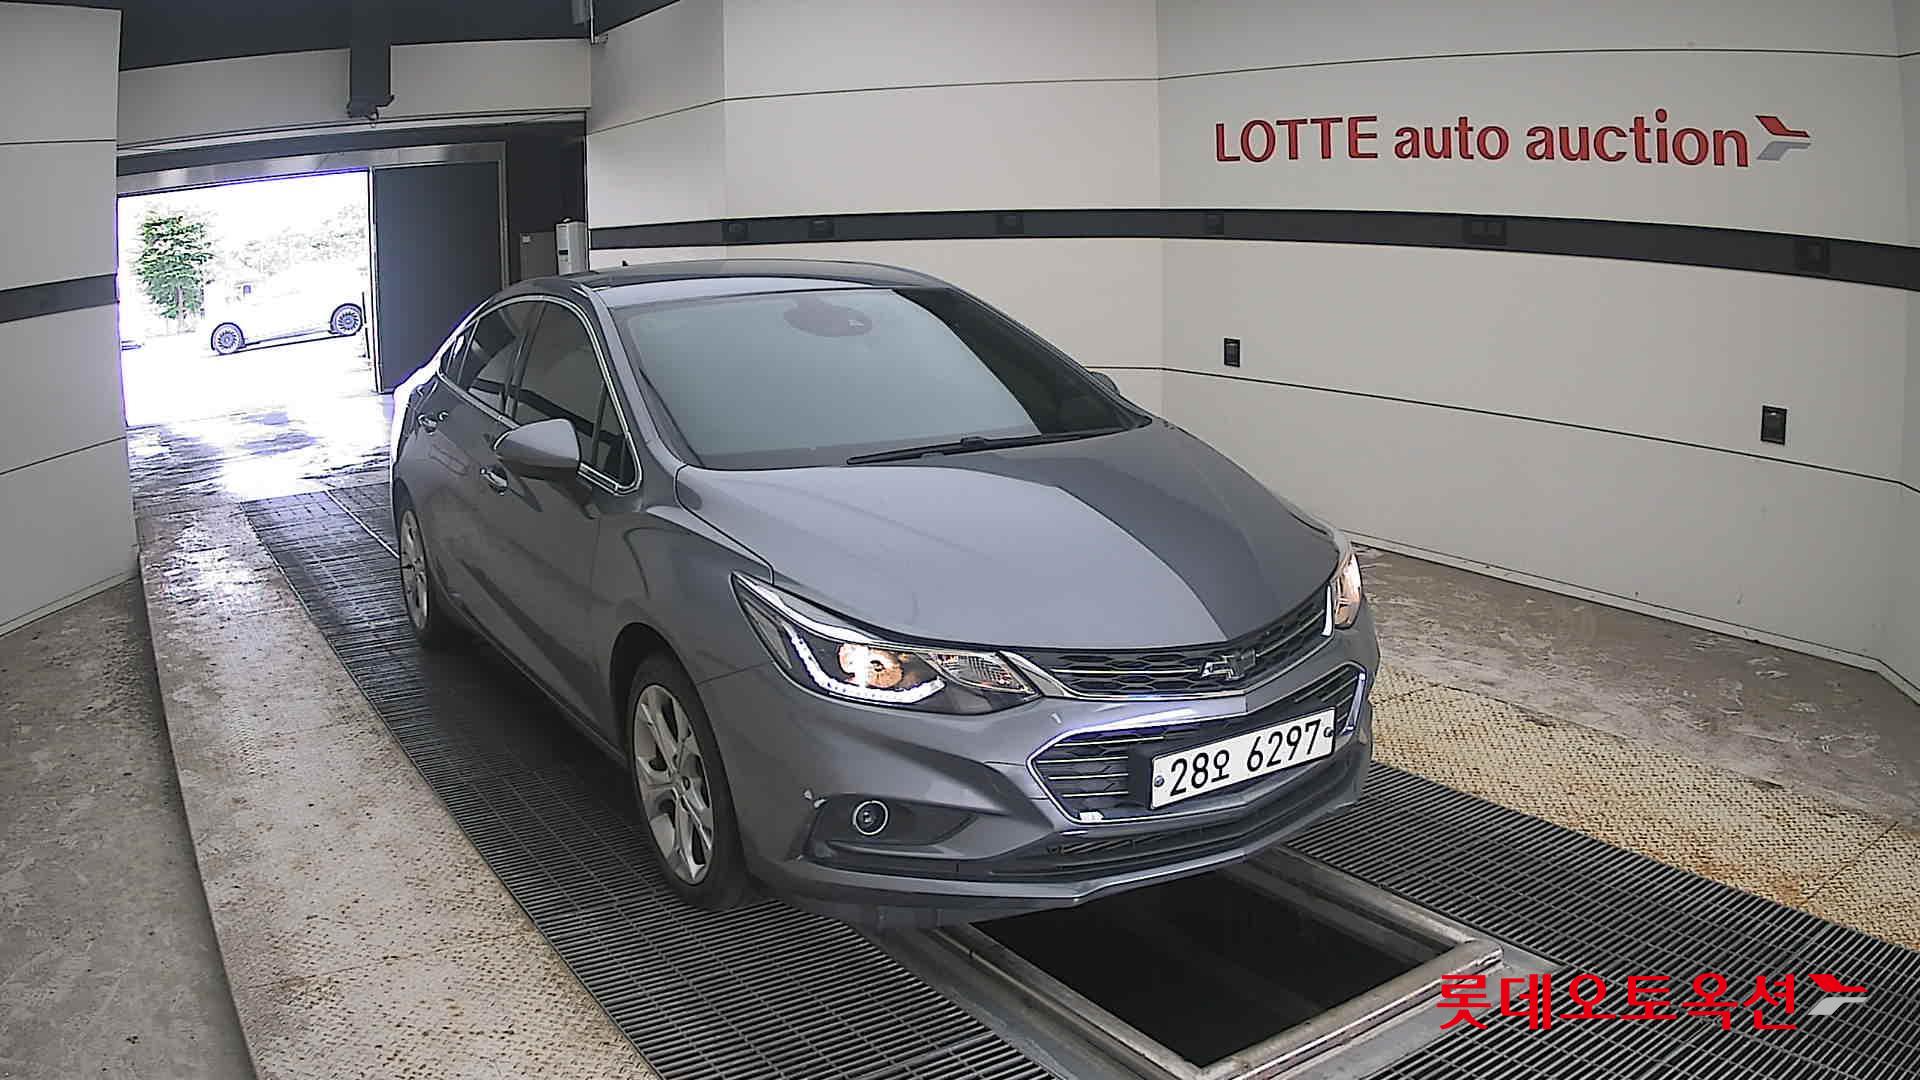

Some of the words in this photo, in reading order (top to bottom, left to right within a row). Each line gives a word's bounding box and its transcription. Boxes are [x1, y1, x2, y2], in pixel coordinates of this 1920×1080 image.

[1215, 115, 1378, 163] LOTTE
[1394, 116, 1510, 161] auto
[1525, 108, 1749, 168] auction
[1169, 749, 1230, 797] 28오
[1246, 718, 1321, 772] 6297
